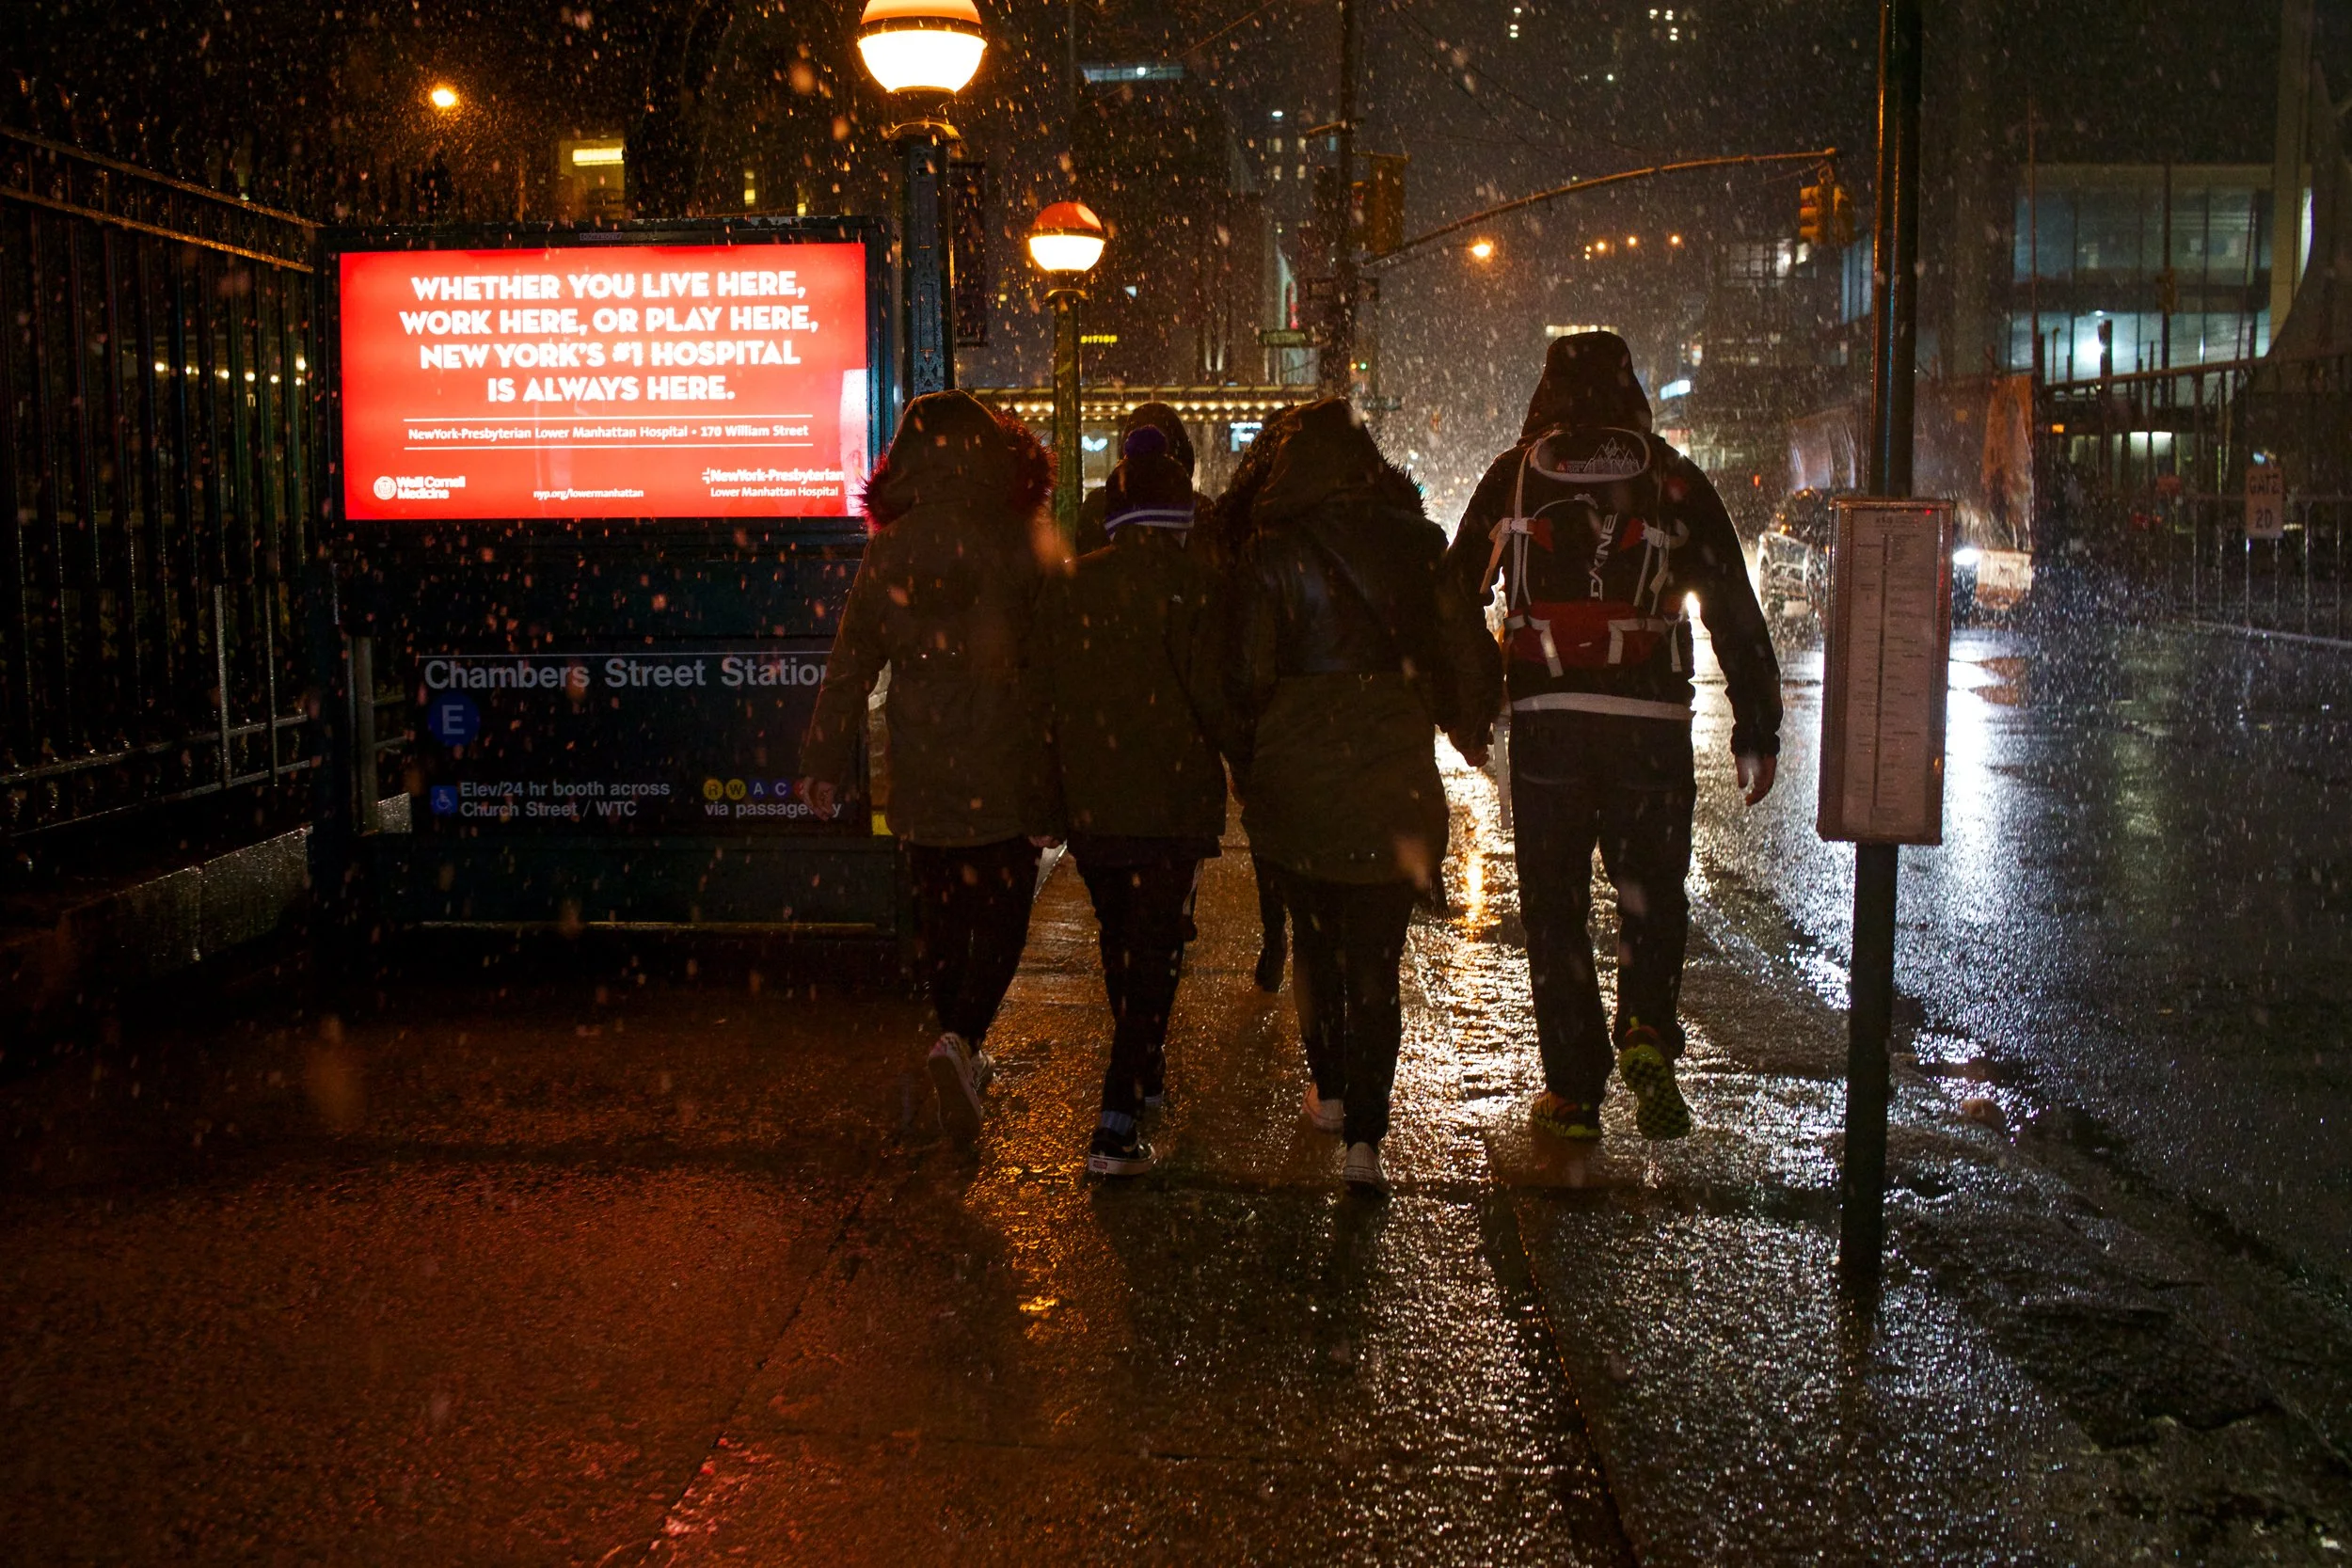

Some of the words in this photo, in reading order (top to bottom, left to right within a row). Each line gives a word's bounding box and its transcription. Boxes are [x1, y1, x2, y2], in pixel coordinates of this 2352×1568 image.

[410, 275, 561, 301] WHETHER
[566, 273, 636, 299] YOU
[643, 272, 710, 297] LIVE
[717, 271, 806, 299] HERE,
[399, 309, 493, 335] WORK
[500, 309, 589, 337] HERE,
[592, 308, 639, 333] OR
[645, 306, 723, 332] PLAY
[730, 306, 819, 333] HERE,
[420, 344, 490, 370] NEW
[493, 342, 606, 368] YORK'S
[612, 341, 644, 367] #1
[650, 340, 802, 367] HOSPITAL
[487, 377, 516, 403] IS
[522, 376, 640, 402] ALWAYS
[646, 375, 736, 401] HERE.
[408, 427, 532, 441] NewYork-Presbyterian
[534, 426, 570, 439] Lower
[573, 426, 637, 439] Manhattan
[640, 425, 688, 440] Hospital
[700, 425, 723, 436] 170
[724, 424, 771, 436] William
[772, 424, 809, 436] Street
[424, 475, 467, 487] Cornell
[709, 467, 845, 484] NewYork-Presbyterian
[2249, 473, 2280, 495] GATE
[397, 487, 450, 499] Medicine
[533, 488, 644, 501] nyp.org/lowermanhattan
[710, 487, 741, 498] Lower
[741, 486, 797, 498] Manhattan
[798, 485, 839, 498] Hospital
[423, 658, 591, 689] Chambers
[604, 658, 707, 688] Street
[441, 704, 466, 735] E
[459, 781, 524, 798] Elev/24
[529, 780, 550, 797] hr
[552, 779, 605, 797] booth
[611, 783, 671, 797] across
[729, 784, 743, 796] W
[754, 783, 764, 795] A
[774, 782, 787, 796] C
[459, 800, 520, 817] Church
[525, 800, 579, 816] Street
[582, 800, 591, 817] /
[595, 800, 640, 816] WTC
[705, 801, 729, 816] via
